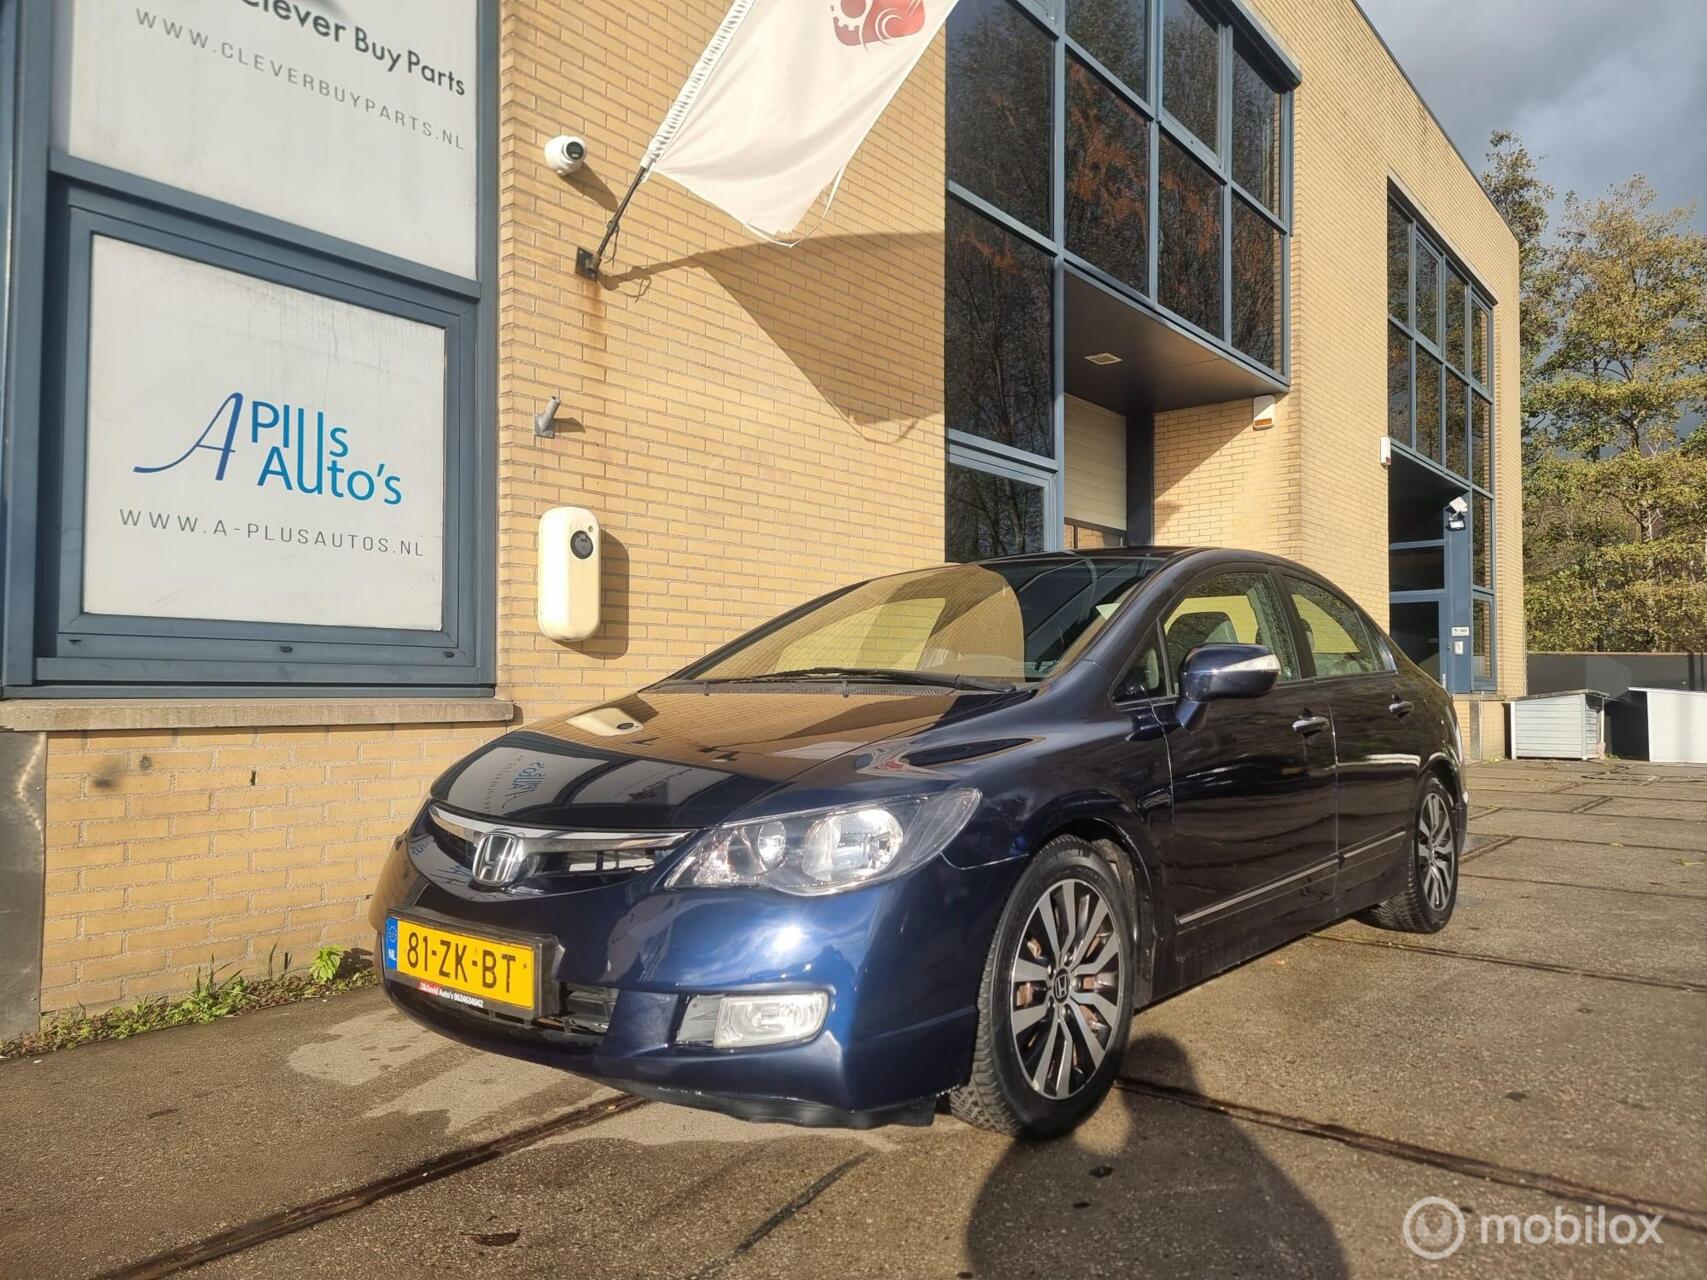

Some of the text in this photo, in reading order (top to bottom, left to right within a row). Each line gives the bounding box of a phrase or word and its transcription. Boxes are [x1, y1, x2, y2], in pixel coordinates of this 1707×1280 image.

[135, 8, 465, 150] WWW.CLEVERBUYPARTS.NL
[241, 0, 466, 96] ever Buy Parts
[118, 508, 425, 557] WWW.A-PLUSAUTOS.NL
[407, 931, 516, 994] 81-ZK-BT
